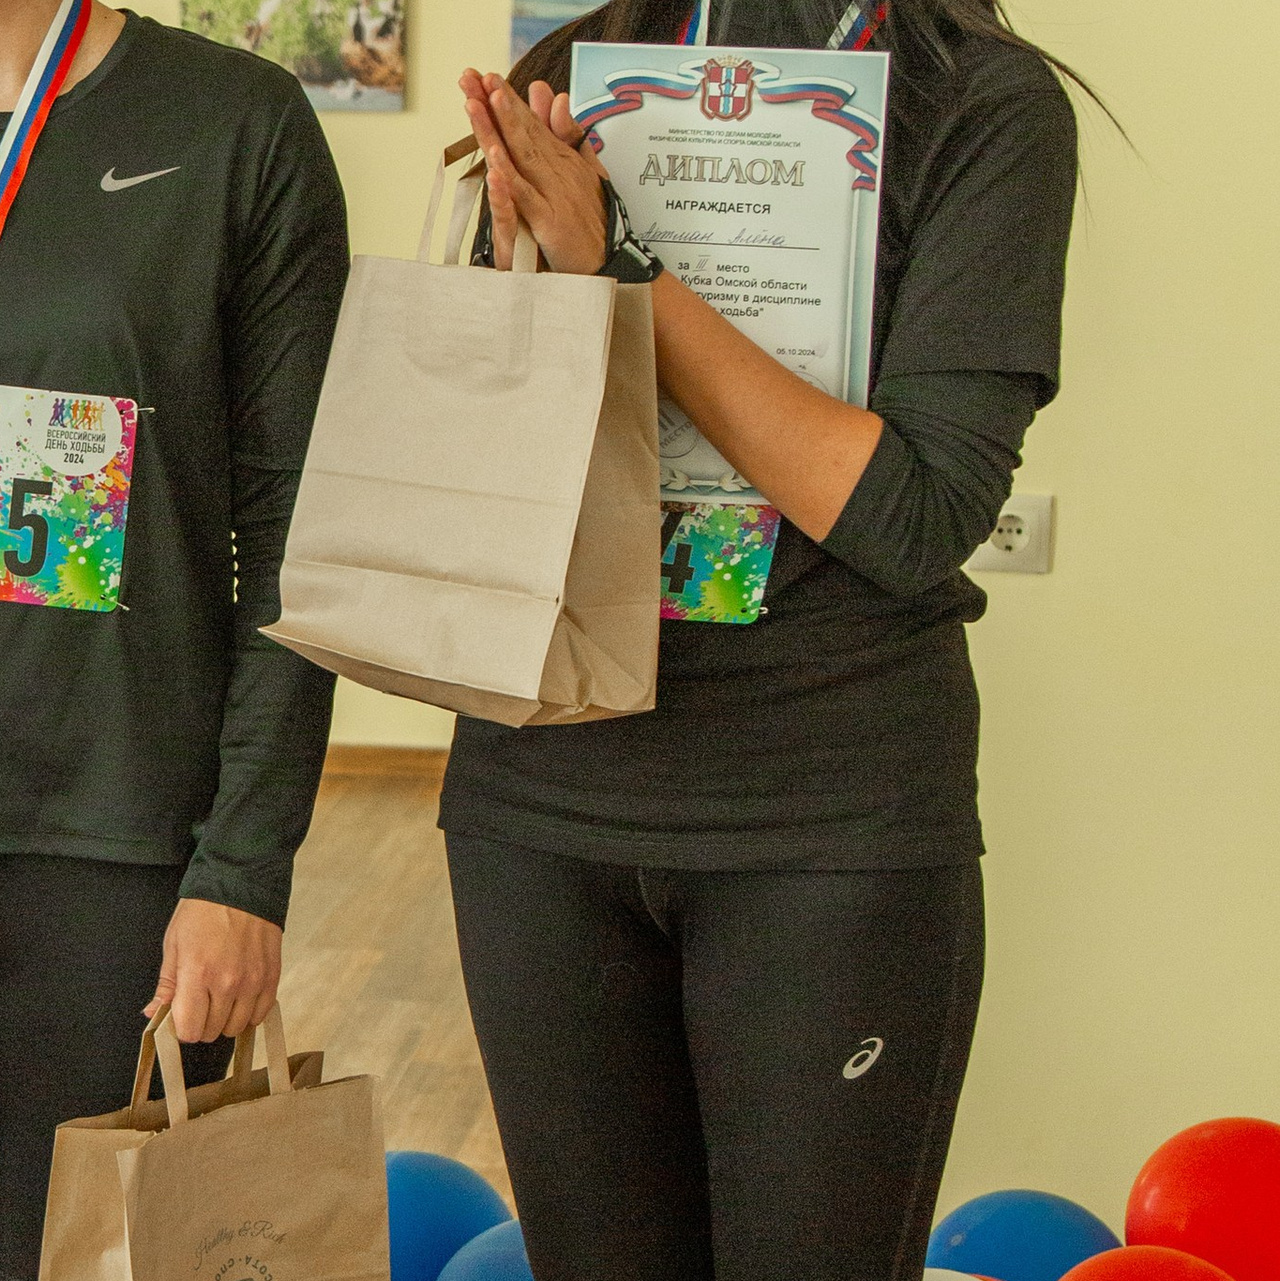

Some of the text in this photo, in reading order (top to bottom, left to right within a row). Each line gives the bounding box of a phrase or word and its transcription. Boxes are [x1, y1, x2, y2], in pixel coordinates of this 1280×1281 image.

[669, 128, 716, 136] МИНИСТЕРСТВО
[649, 135, 687, 143] ФИЗИЧЕСКОЙ
[688, 136, 716, 145] КУЛЬТУРЫ
[747, 139, 772, 147] ОМСКОЙ
[773, 140, 800, 148] ОБЛАСТИ
[639, 154, 805, 186] ДИПЛОМ
[666, 200, 770, 214] НАГРАЖДАЕТСЯ
[678, 261, 690, 270] за
[716, 263, 749, 274] место
[681, 274, 807, 290] Кубка Омской области
[743, 294, 749, 302] в
[752, 294, 821, 306] дисциплине
[720, 307, 764, 317] ходьба"
[47, 429, 106, 442] ВСЕРОССИЙСКИЙ
[45, 439, 105, 453] ДЕНЬ ХОДЬБЫ
[64, 453, 84, 464] 2024
[238, 1222, 251, 1237] &
[250, 1221, 289, 1245] Rich
